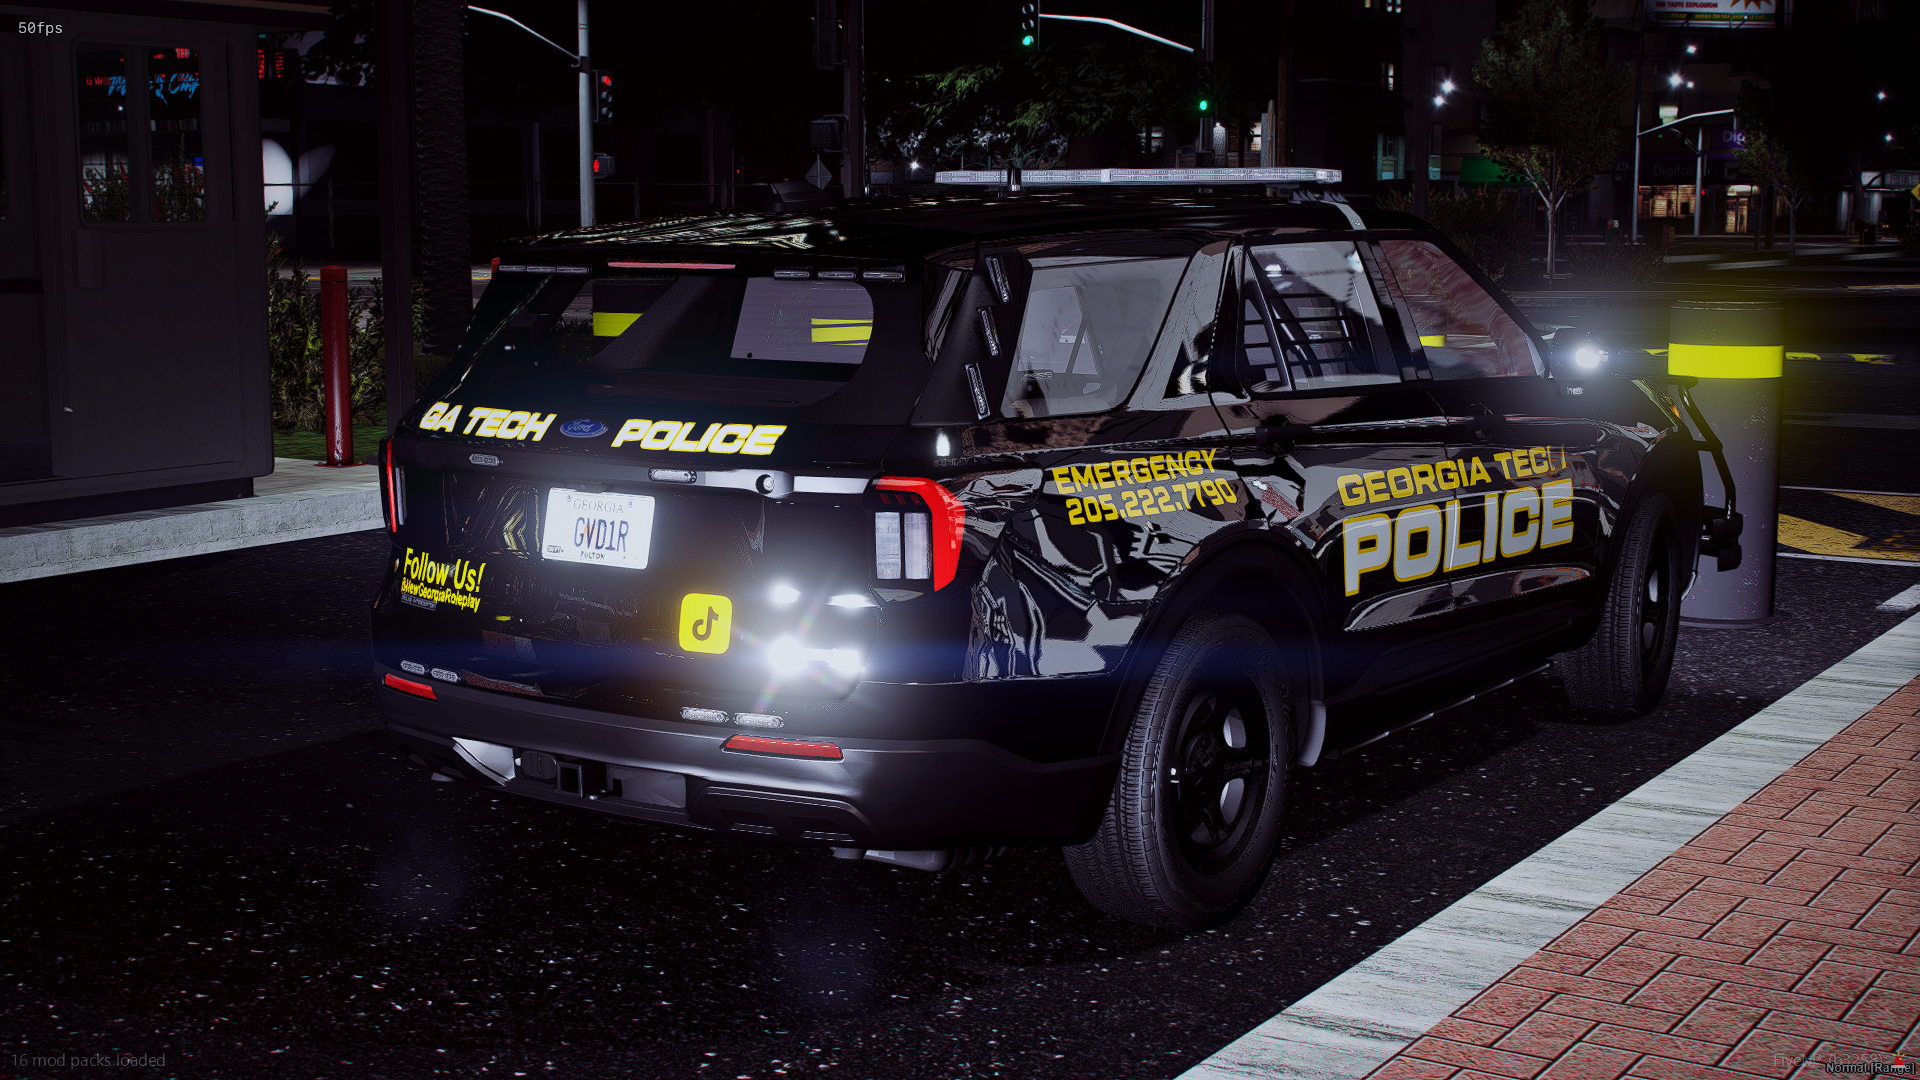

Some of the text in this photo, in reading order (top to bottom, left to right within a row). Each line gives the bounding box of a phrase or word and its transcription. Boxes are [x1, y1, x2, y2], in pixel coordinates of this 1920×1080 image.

[418, 401, 558, 442] GA TECH
[610, 418, 788, 456] POLICE
[1051, 448, 1217, 495] EMERGENCY
[1336, 455, 1493, 507] GEORGIA
[573, 498, 624, 514] GEORGIA
[1065, 477, 1238, 526] 205.222.7790
[573, 516, 630, 553] GVD1R
[1342, 477, 1575, 598] POLICE
[403, 546, 487, 593] Follow Us!
